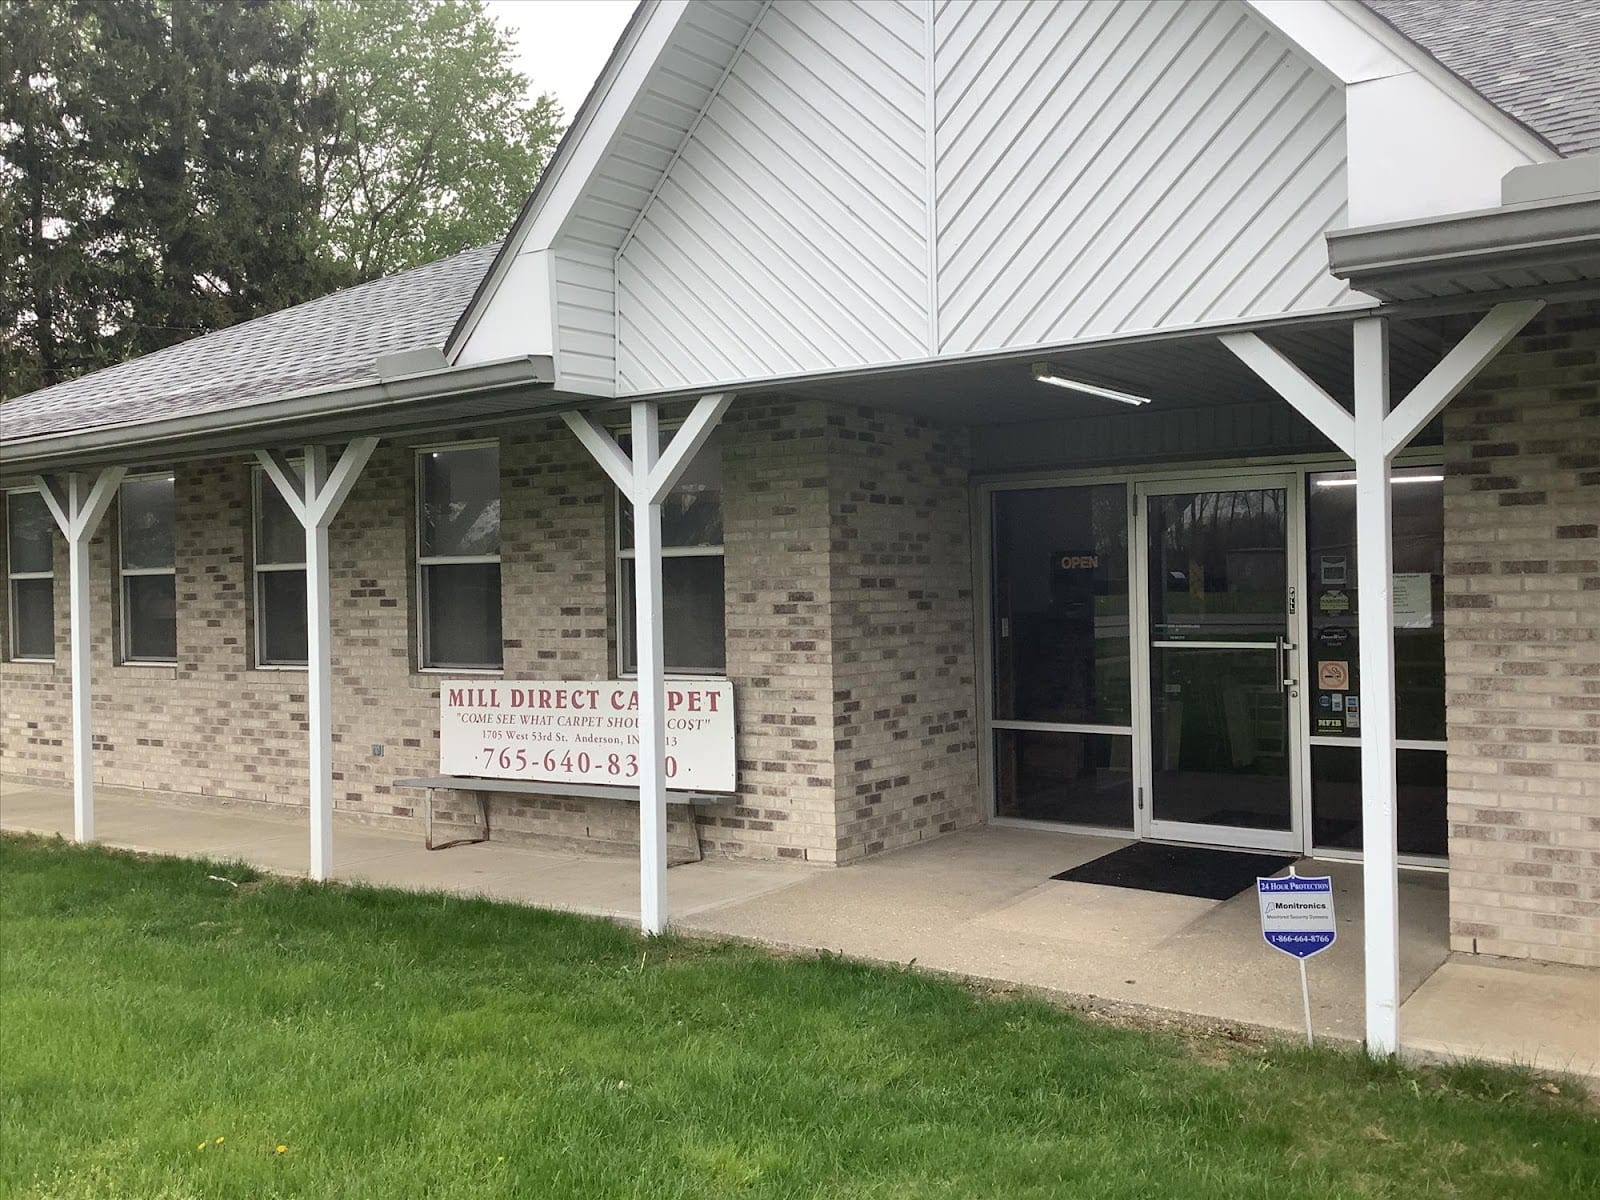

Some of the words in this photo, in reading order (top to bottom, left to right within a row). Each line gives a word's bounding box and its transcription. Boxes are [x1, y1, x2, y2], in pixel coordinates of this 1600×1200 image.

[1061, 556, 1098, 569] OPEN
[448, 688, 501, 708] MILL
[510, 689, 600, 710] DIRECT
[610, 690, 721, 712] CAPET
[456, 712, 494, 725] "COME
[495, 713, 517, 725] SEE
[519, 714, 554, 727] WHAT
[556, 715, 604, 728] CARPET
[667, 718, 711, 731] COST"
[482, 730, 503, 741] 1705
[505, 731, 529, 742] West
[531, 731, 553, 742] 53rd
[555, 732, 569, 742] St.
[574, 733, 624, 746] Anderson,
[482, 746, 678, 779] 765-640-830
